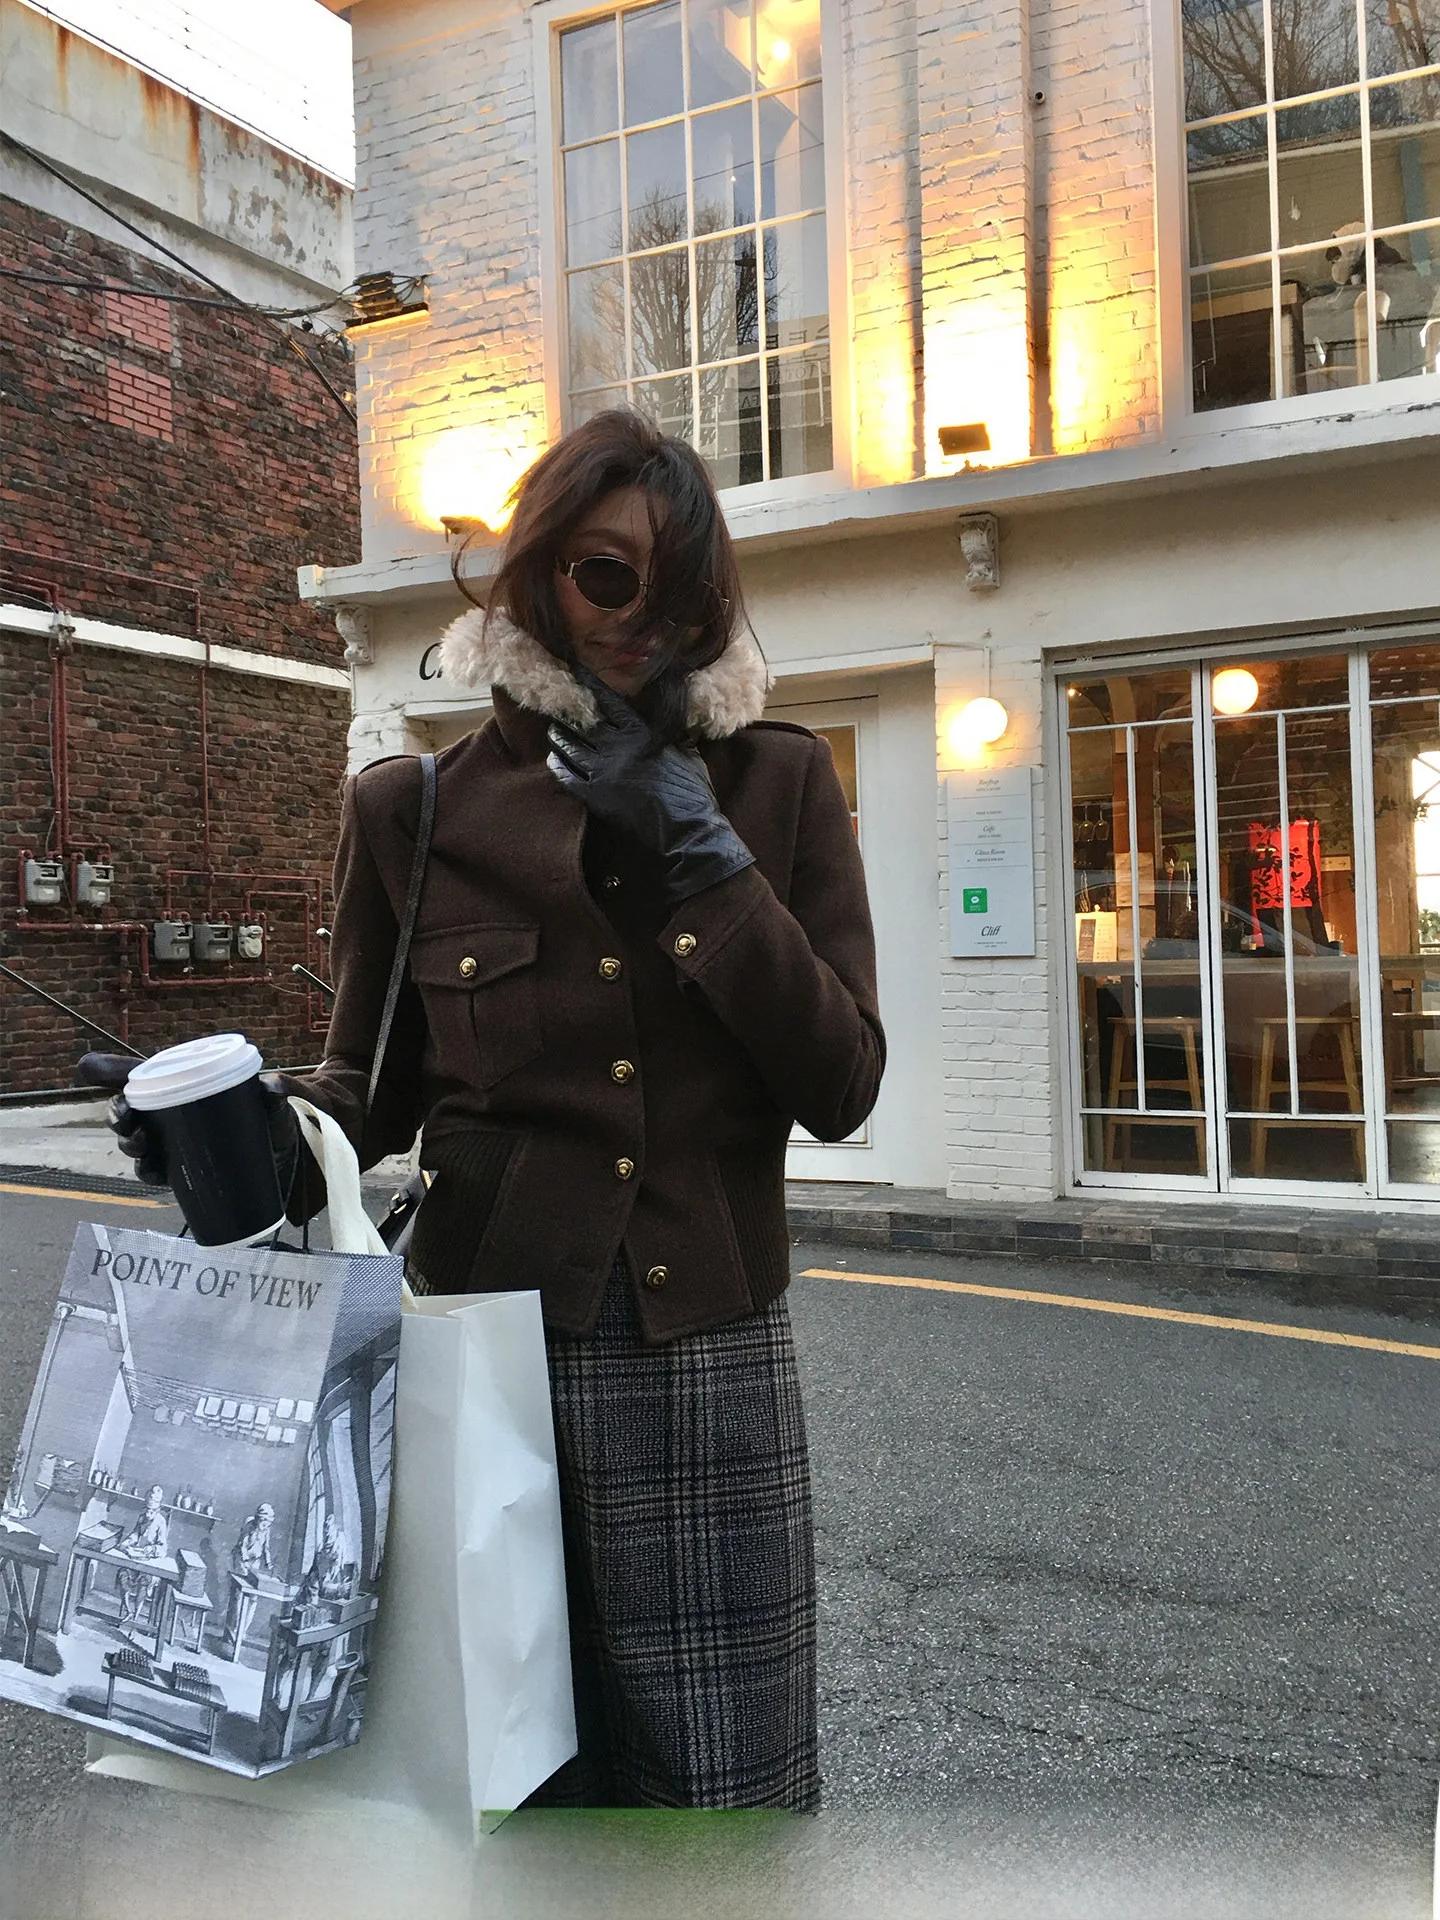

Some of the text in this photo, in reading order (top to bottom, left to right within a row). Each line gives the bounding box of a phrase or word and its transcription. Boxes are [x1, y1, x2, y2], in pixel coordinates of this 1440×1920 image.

[981, 925, 1002, 937] Cliff
[91, 1249, 322, 1310] POINT OF VIEW
